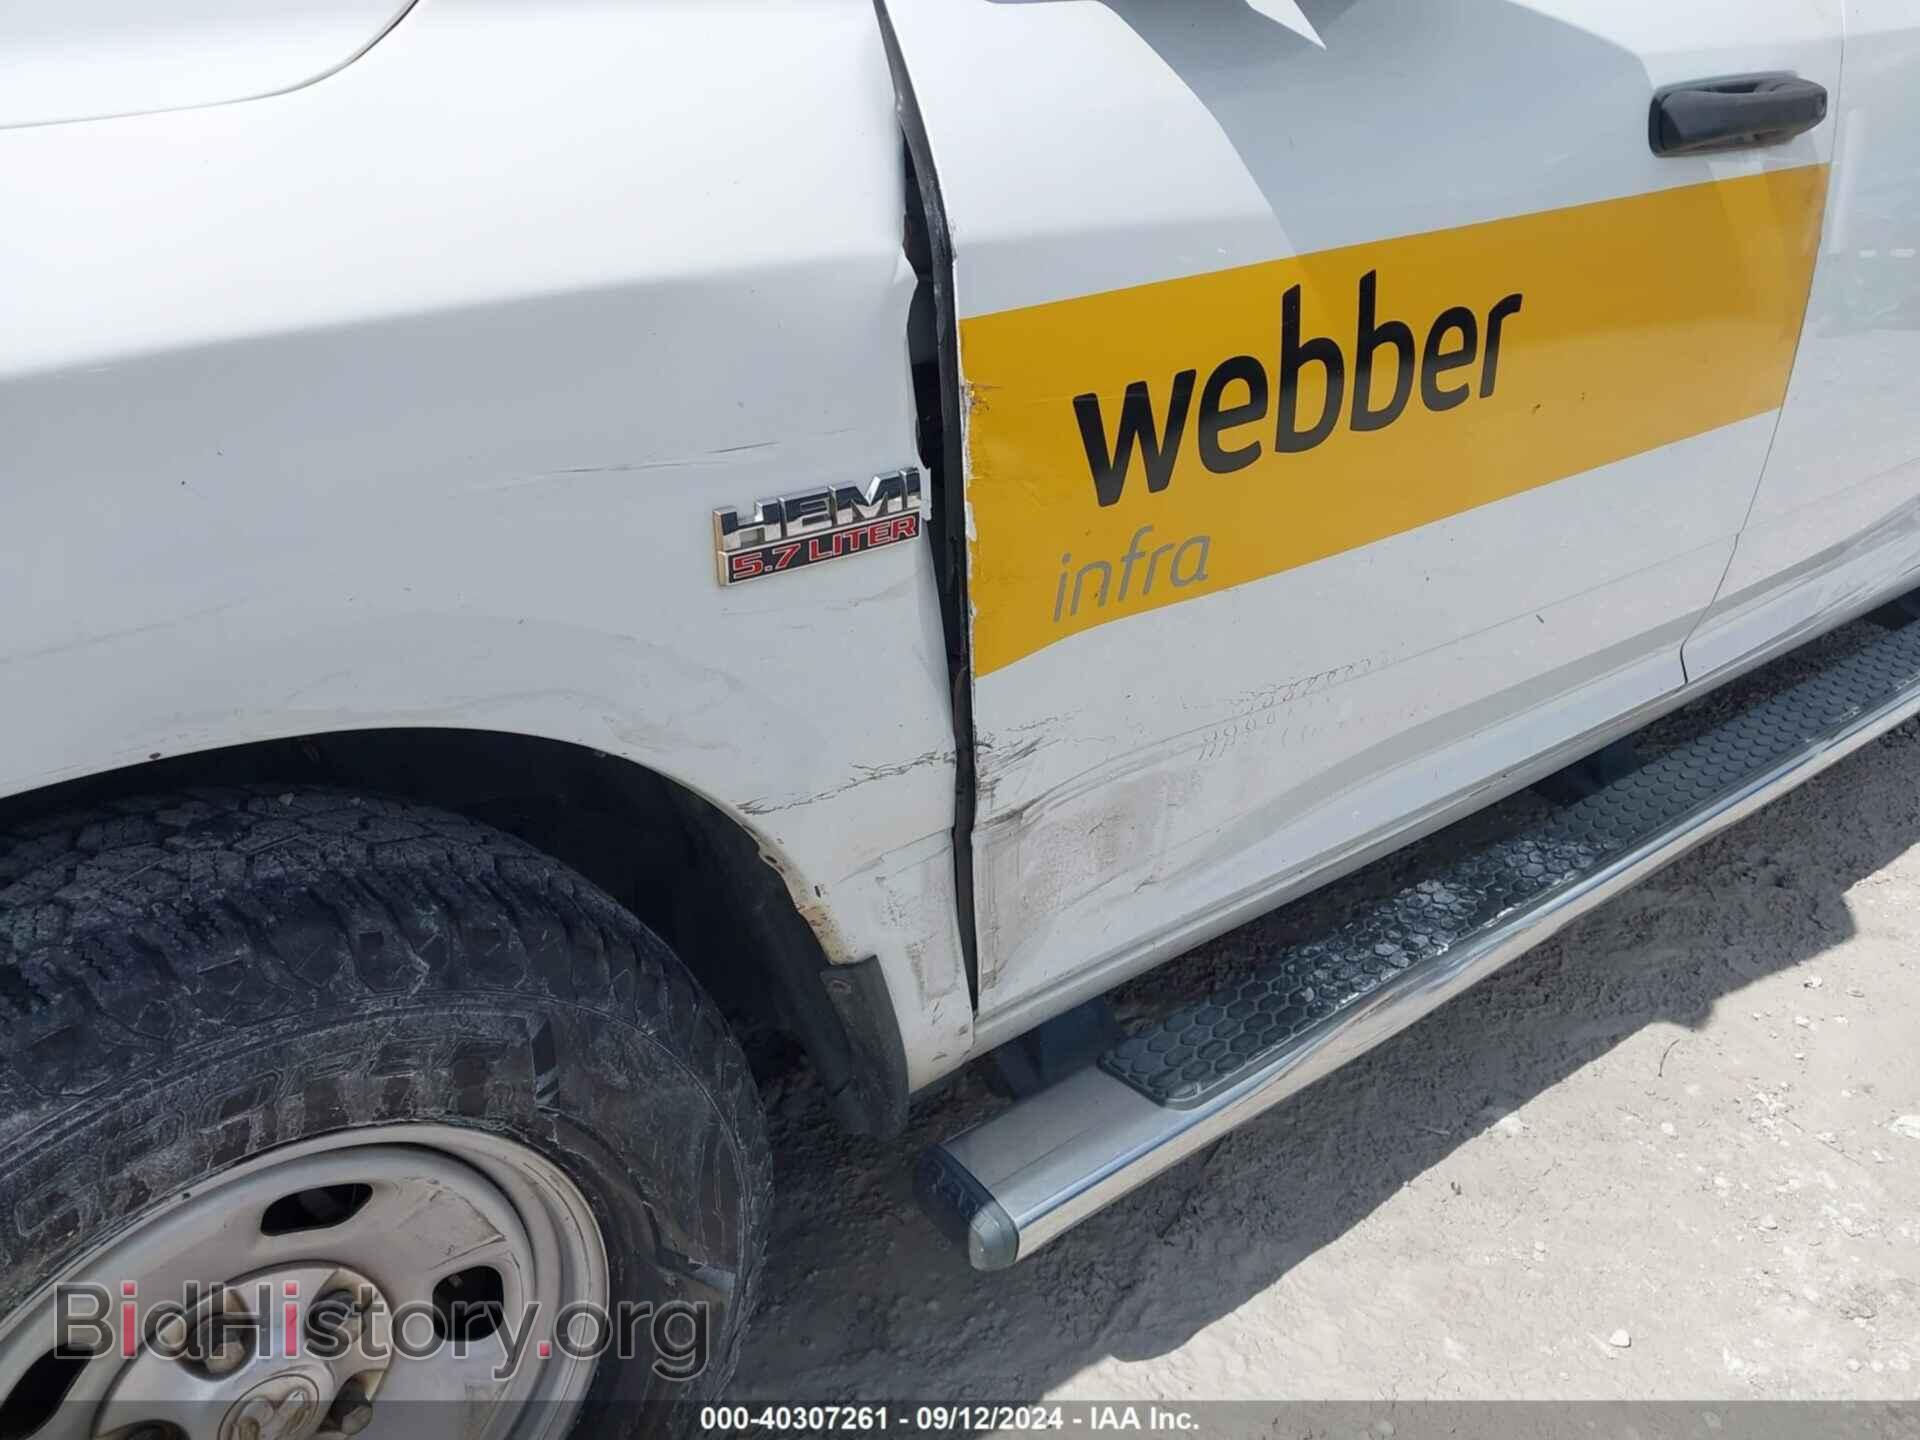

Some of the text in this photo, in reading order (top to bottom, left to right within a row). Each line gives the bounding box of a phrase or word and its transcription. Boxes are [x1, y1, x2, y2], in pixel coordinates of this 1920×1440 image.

[1073, 269, 1523, 508] webber
[713, 467, 921, 551] HEMI
[733, 515, 917, 580] 5.7 LITER
[1053, 525, 1211, 623] infra
